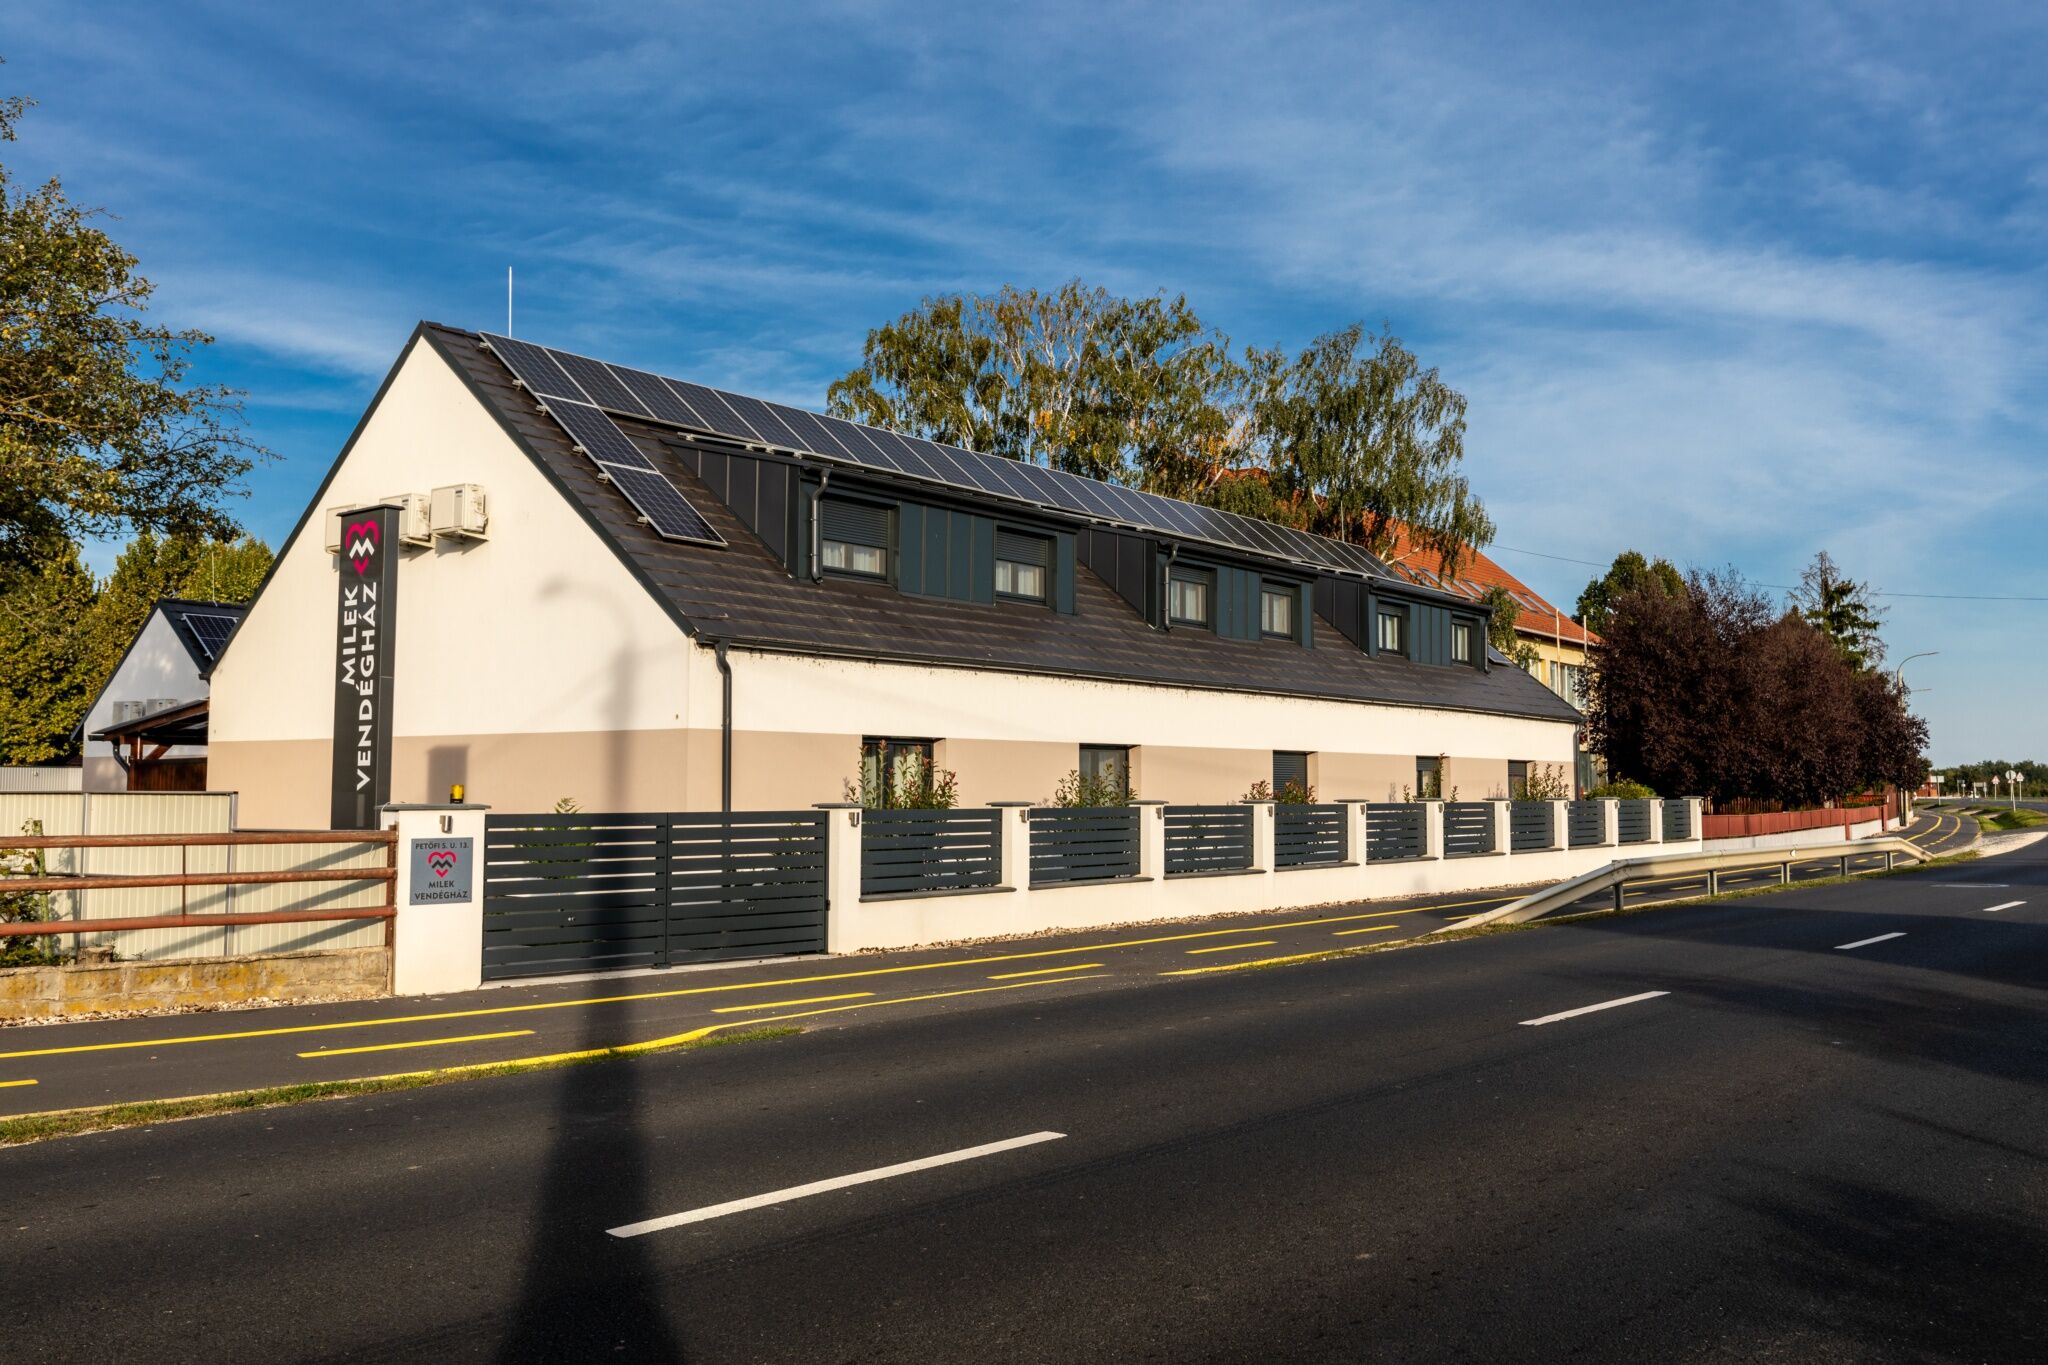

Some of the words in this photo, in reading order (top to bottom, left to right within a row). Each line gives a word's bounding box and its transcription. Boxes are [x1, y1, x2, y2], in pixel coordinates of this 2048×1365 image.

[342, 585, 358, 685] MILEK
[356, 582, 377, 791] VENDÉGHÁZ
[415, 889, 468, 900] VENDÉGHÁZ
[428, 880, 455, 889] MILEK
